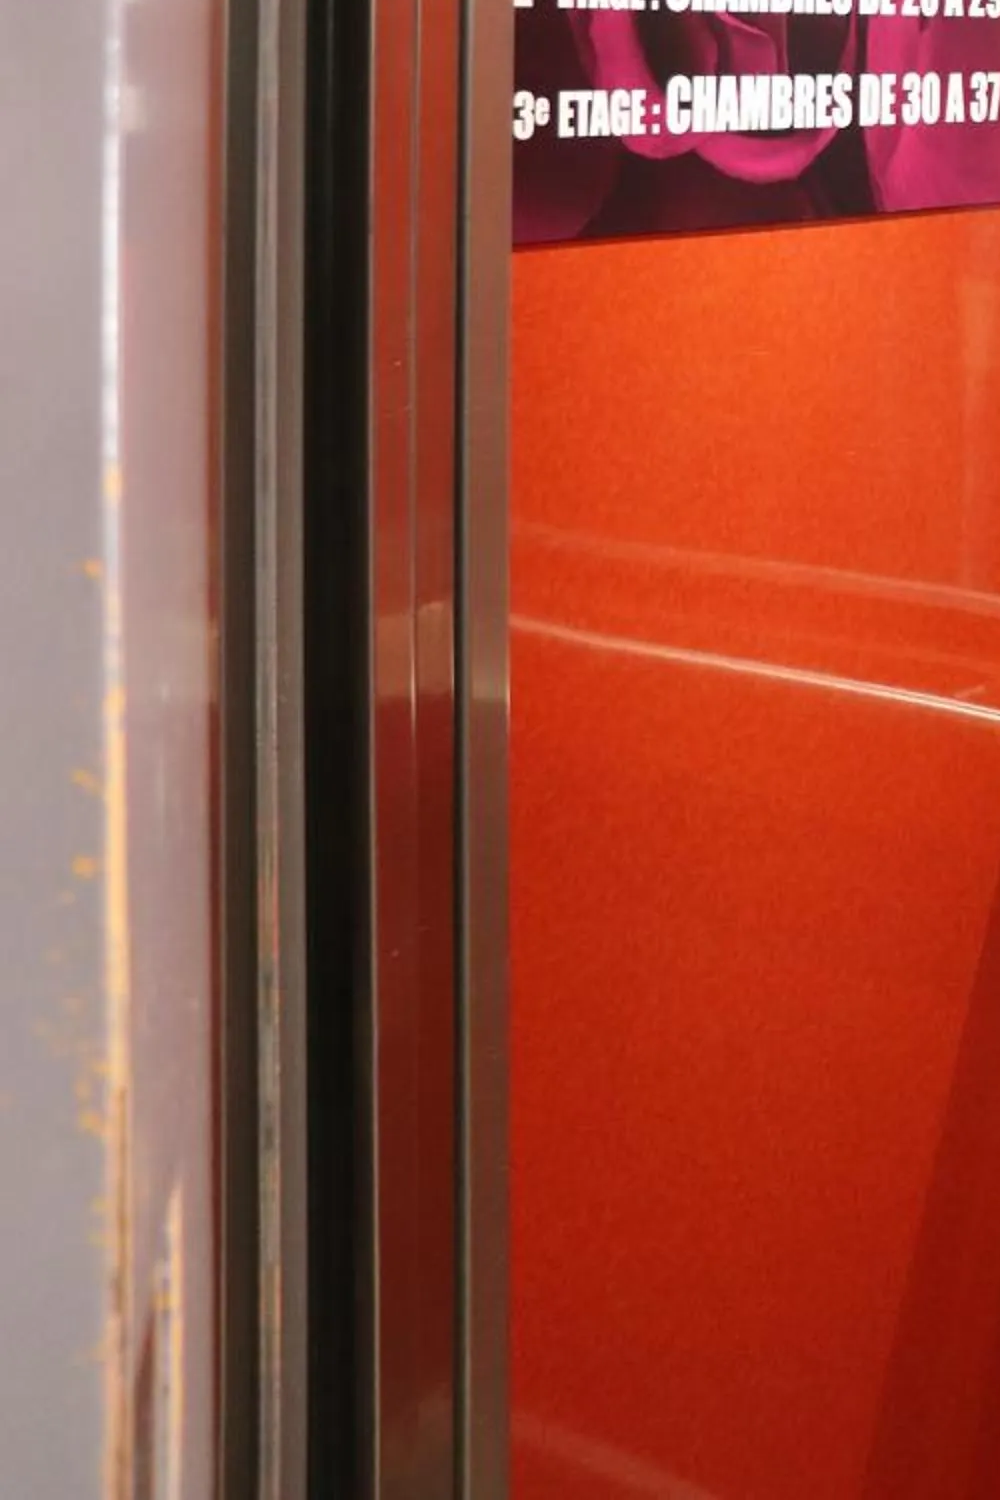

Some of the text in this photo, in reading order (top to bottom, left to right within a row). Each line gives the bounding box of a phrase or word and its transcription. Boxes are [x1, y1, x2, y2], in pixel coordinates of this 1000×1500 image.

[666, 73, 853, 135] CHAMBRES
[859, 73, 897, 127] DE
[901, 73, 941, 125] 30
[945, 72, 965, 123] A
